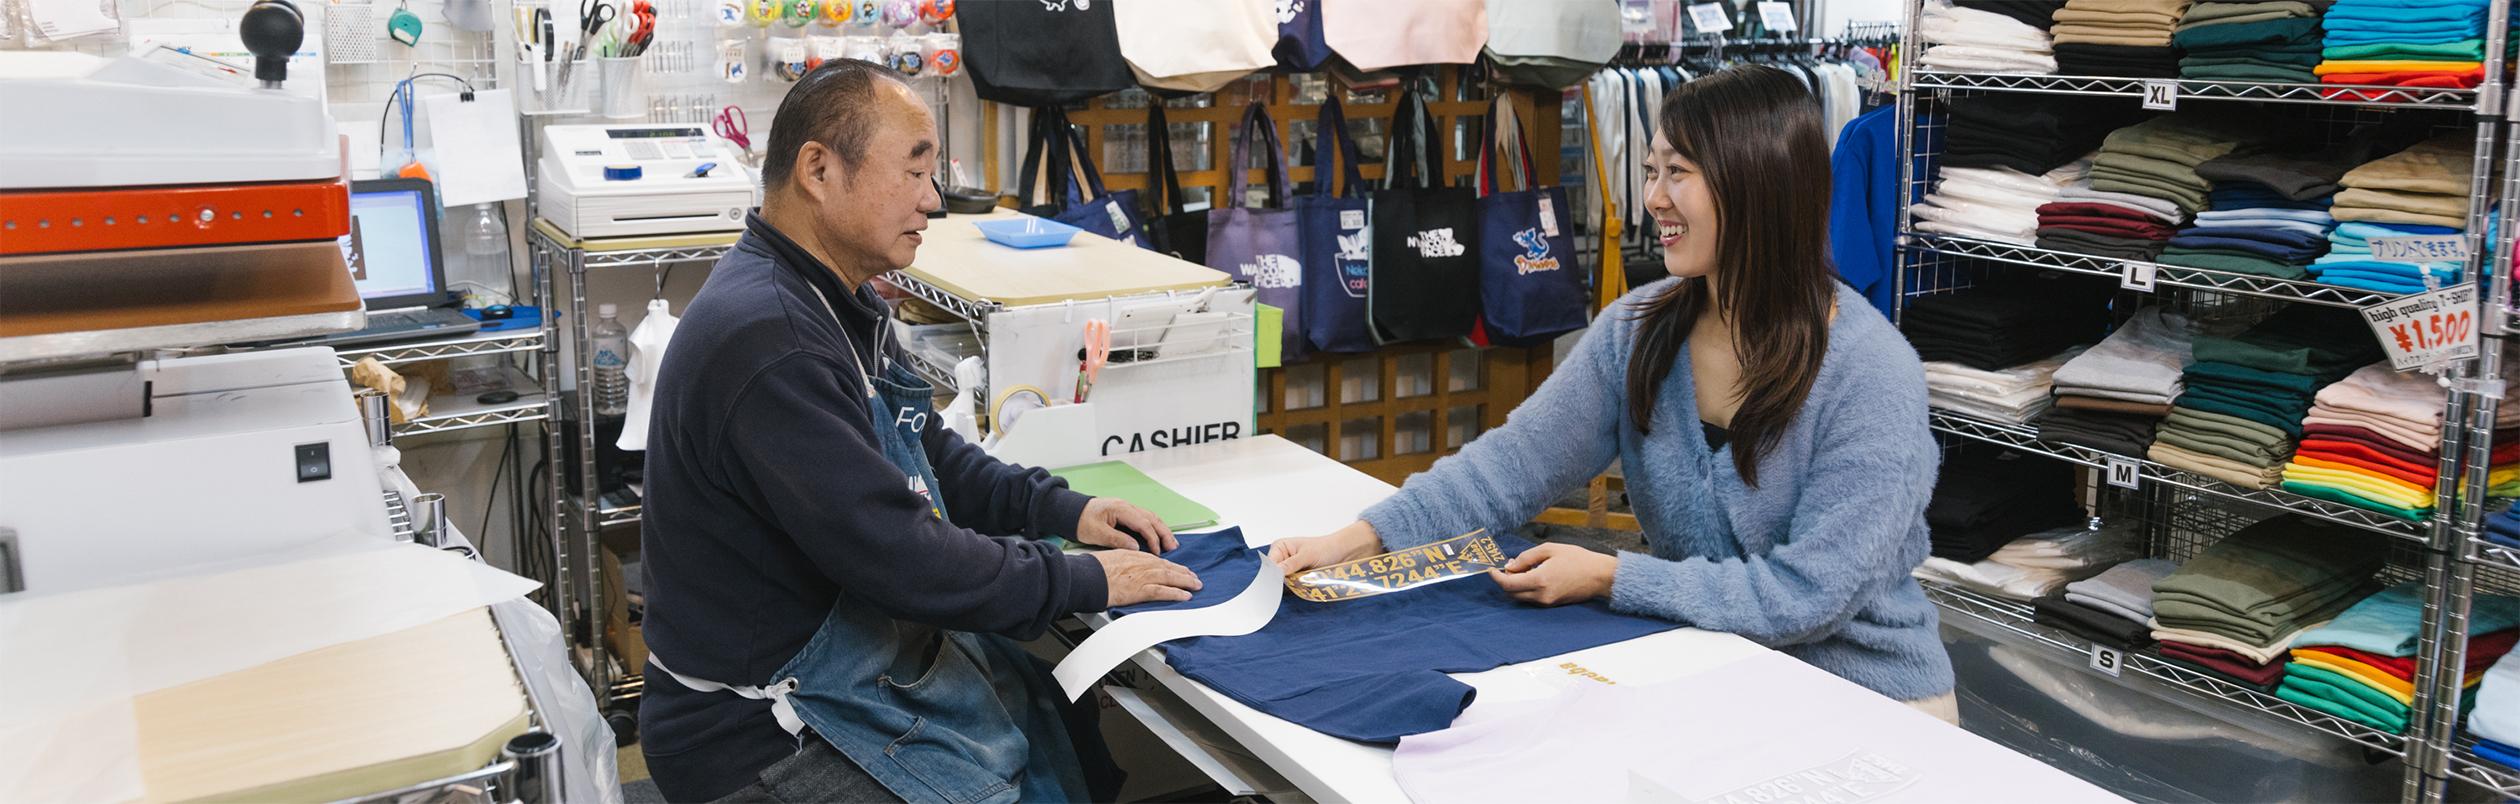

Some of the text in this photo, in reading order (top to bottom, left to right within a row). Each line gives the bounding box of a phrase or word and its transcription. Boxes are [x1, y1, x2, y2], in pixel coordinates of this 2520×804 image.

[2149, 86, 2171, 105] XL
[2130, 267, 2146, 286] L
[2369, 306, 2398, 323] high
[2400, 298, 2440, 318] quality
[2388, 310, 2470, 353] ¥1,500
[1101, 421, 1241, 456] CASHIER
[2115, 464, 2132, 483] M
[2099, 650, 2114, 669] S
